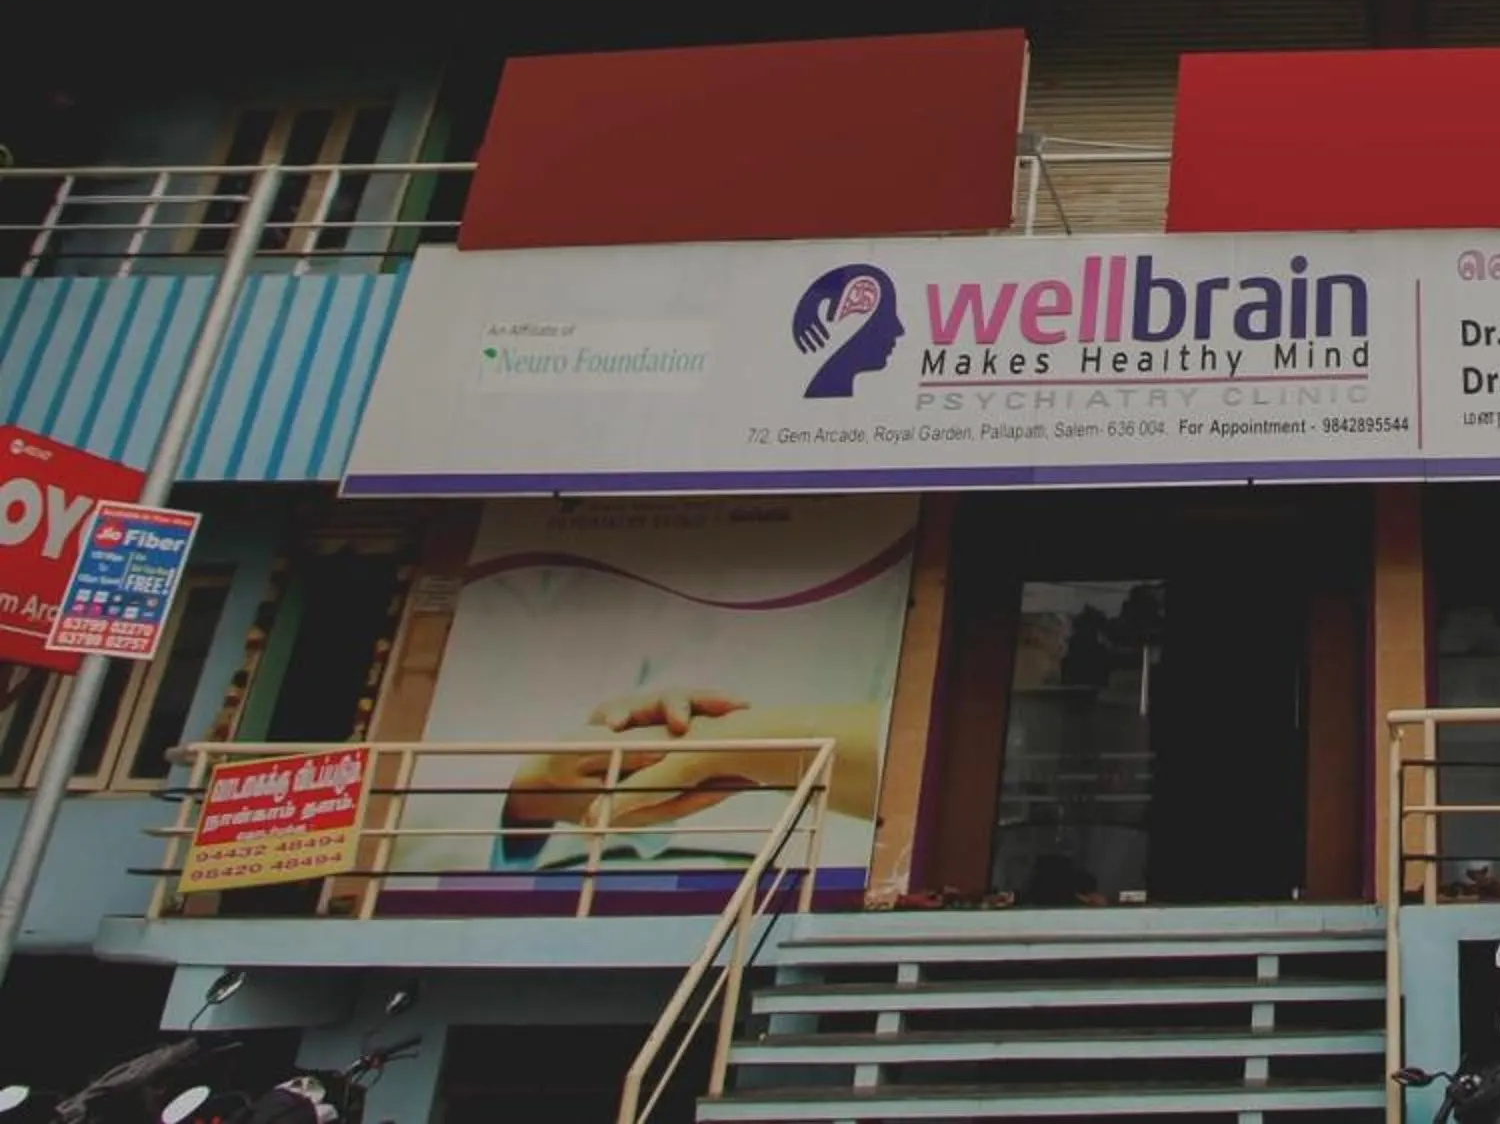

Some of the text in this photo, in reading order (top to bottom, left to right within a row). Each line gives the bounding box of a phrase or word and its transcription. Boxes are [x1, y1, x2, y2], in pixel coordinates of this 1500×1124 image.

[926, 254, 1369, 345] wellbrain
[497, 346, 706, 374] Neuro Foundation
[921, 341, 1370, 378] Makes Healthy Mind
[915, 384, 1370, 412] PSYCHIATRY CLINIC
[777, 427, 811, 444] Gem
[813, 426, 870, 445] Arcade,
[873, 425, 915, 447] Royal
[918, 424, 976, 443] Garden,
[1107, 420, 1136, 437] 636
[1178, 419, 1203, 435] For
[1209, 417, 1307, 439] Appointment
[1322, 416, 1410, 434] 9842895544
[0, 477, 97, 560] OY
[123, 529, 186, 553] Fiber
